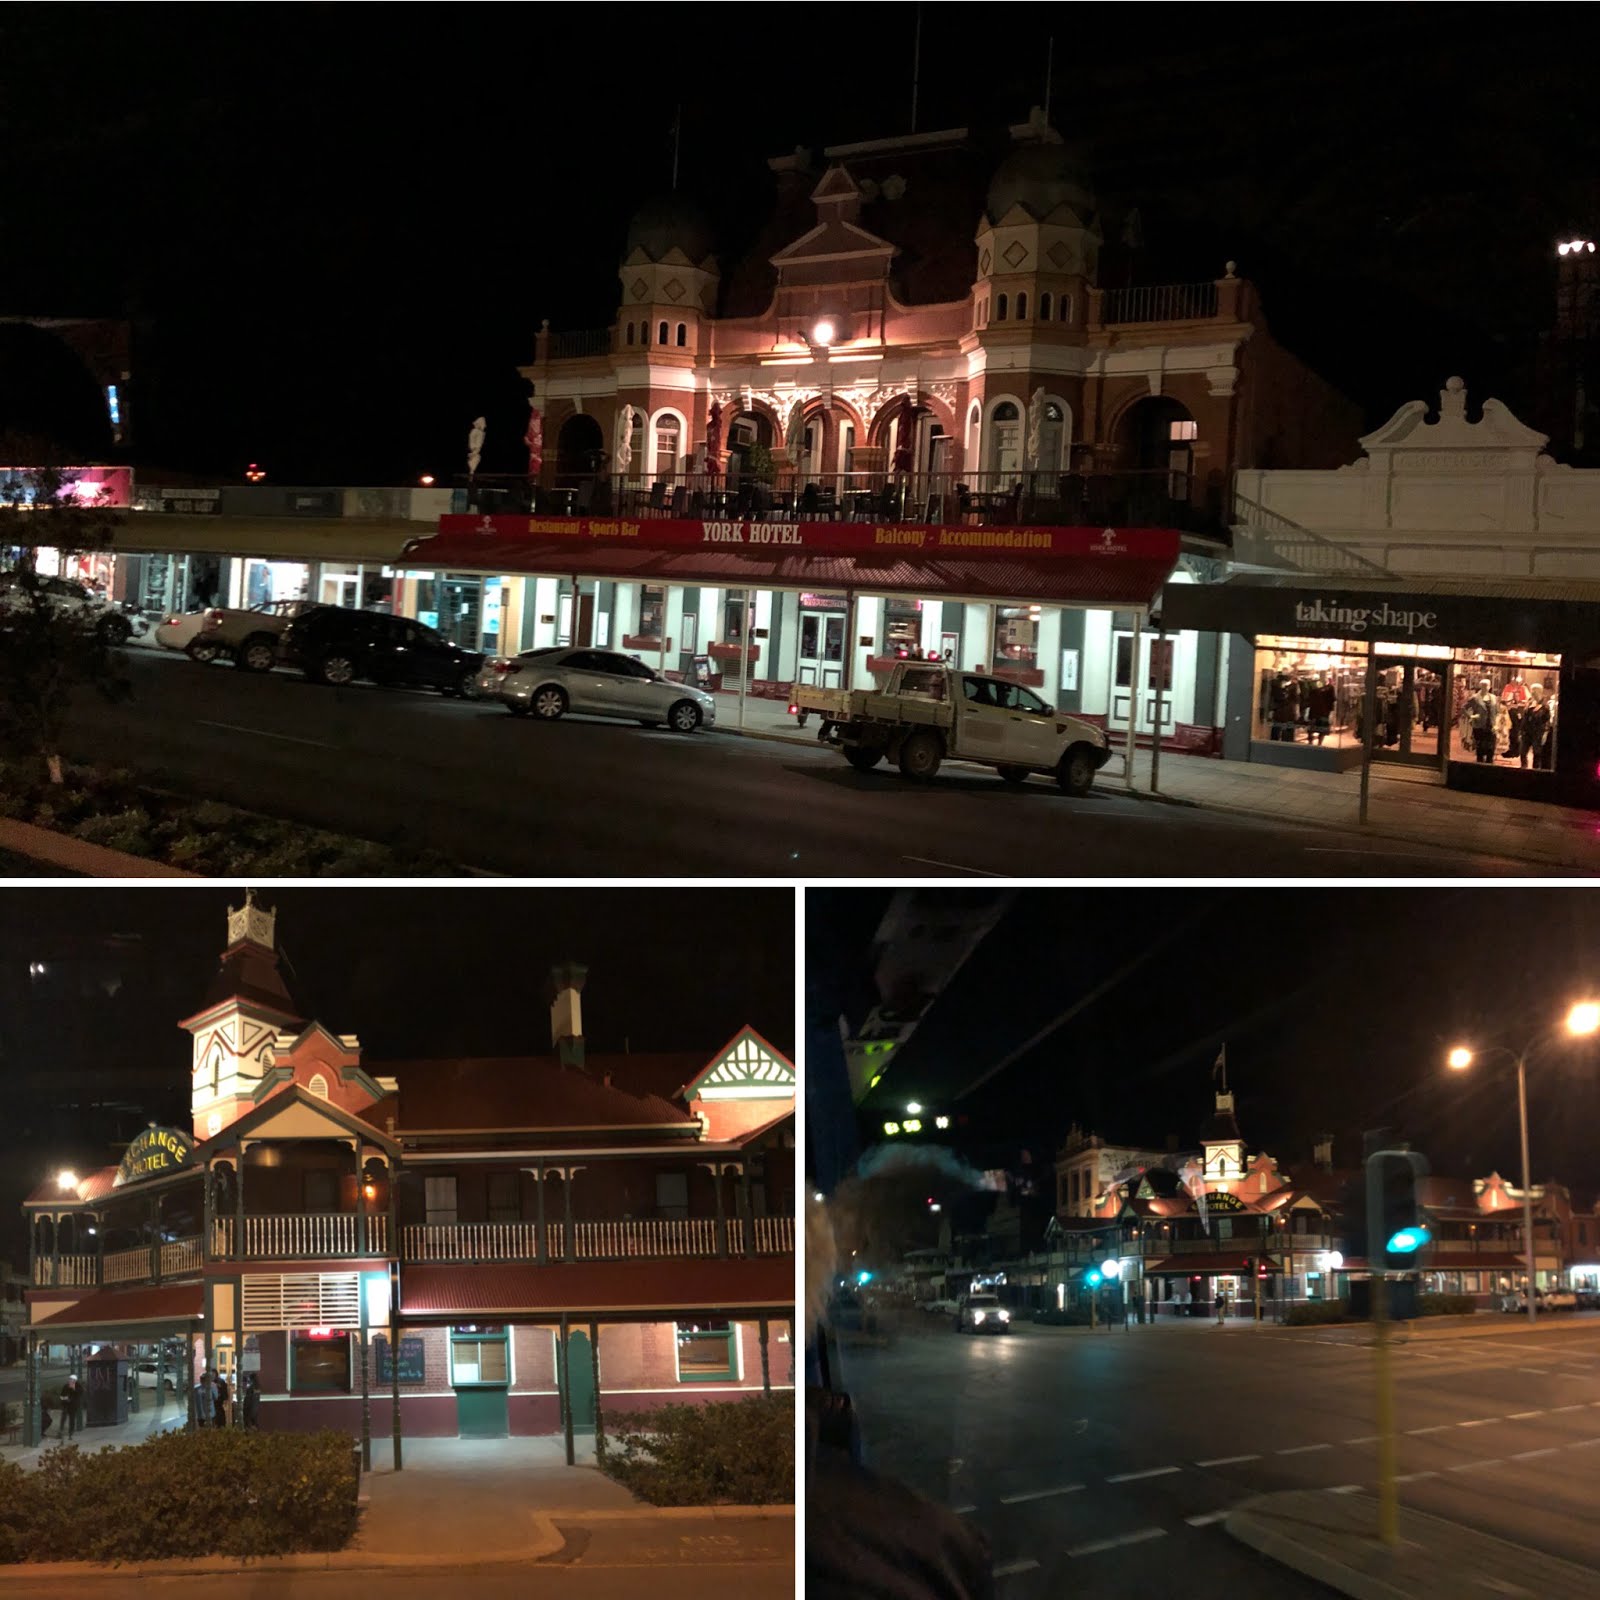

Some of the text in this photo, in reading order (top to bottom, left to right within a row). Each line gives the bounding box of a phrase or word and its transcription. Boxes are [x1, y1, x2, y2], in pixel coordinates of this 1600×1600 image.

[529, 520, 640, 537] Restaurant Sports Bar
[703, 522, 801, 544] YORK HOTEL
[875, 527, 1052, 549] Balcony Accommodation
[1296, 600, 1437, 635] taking shape
